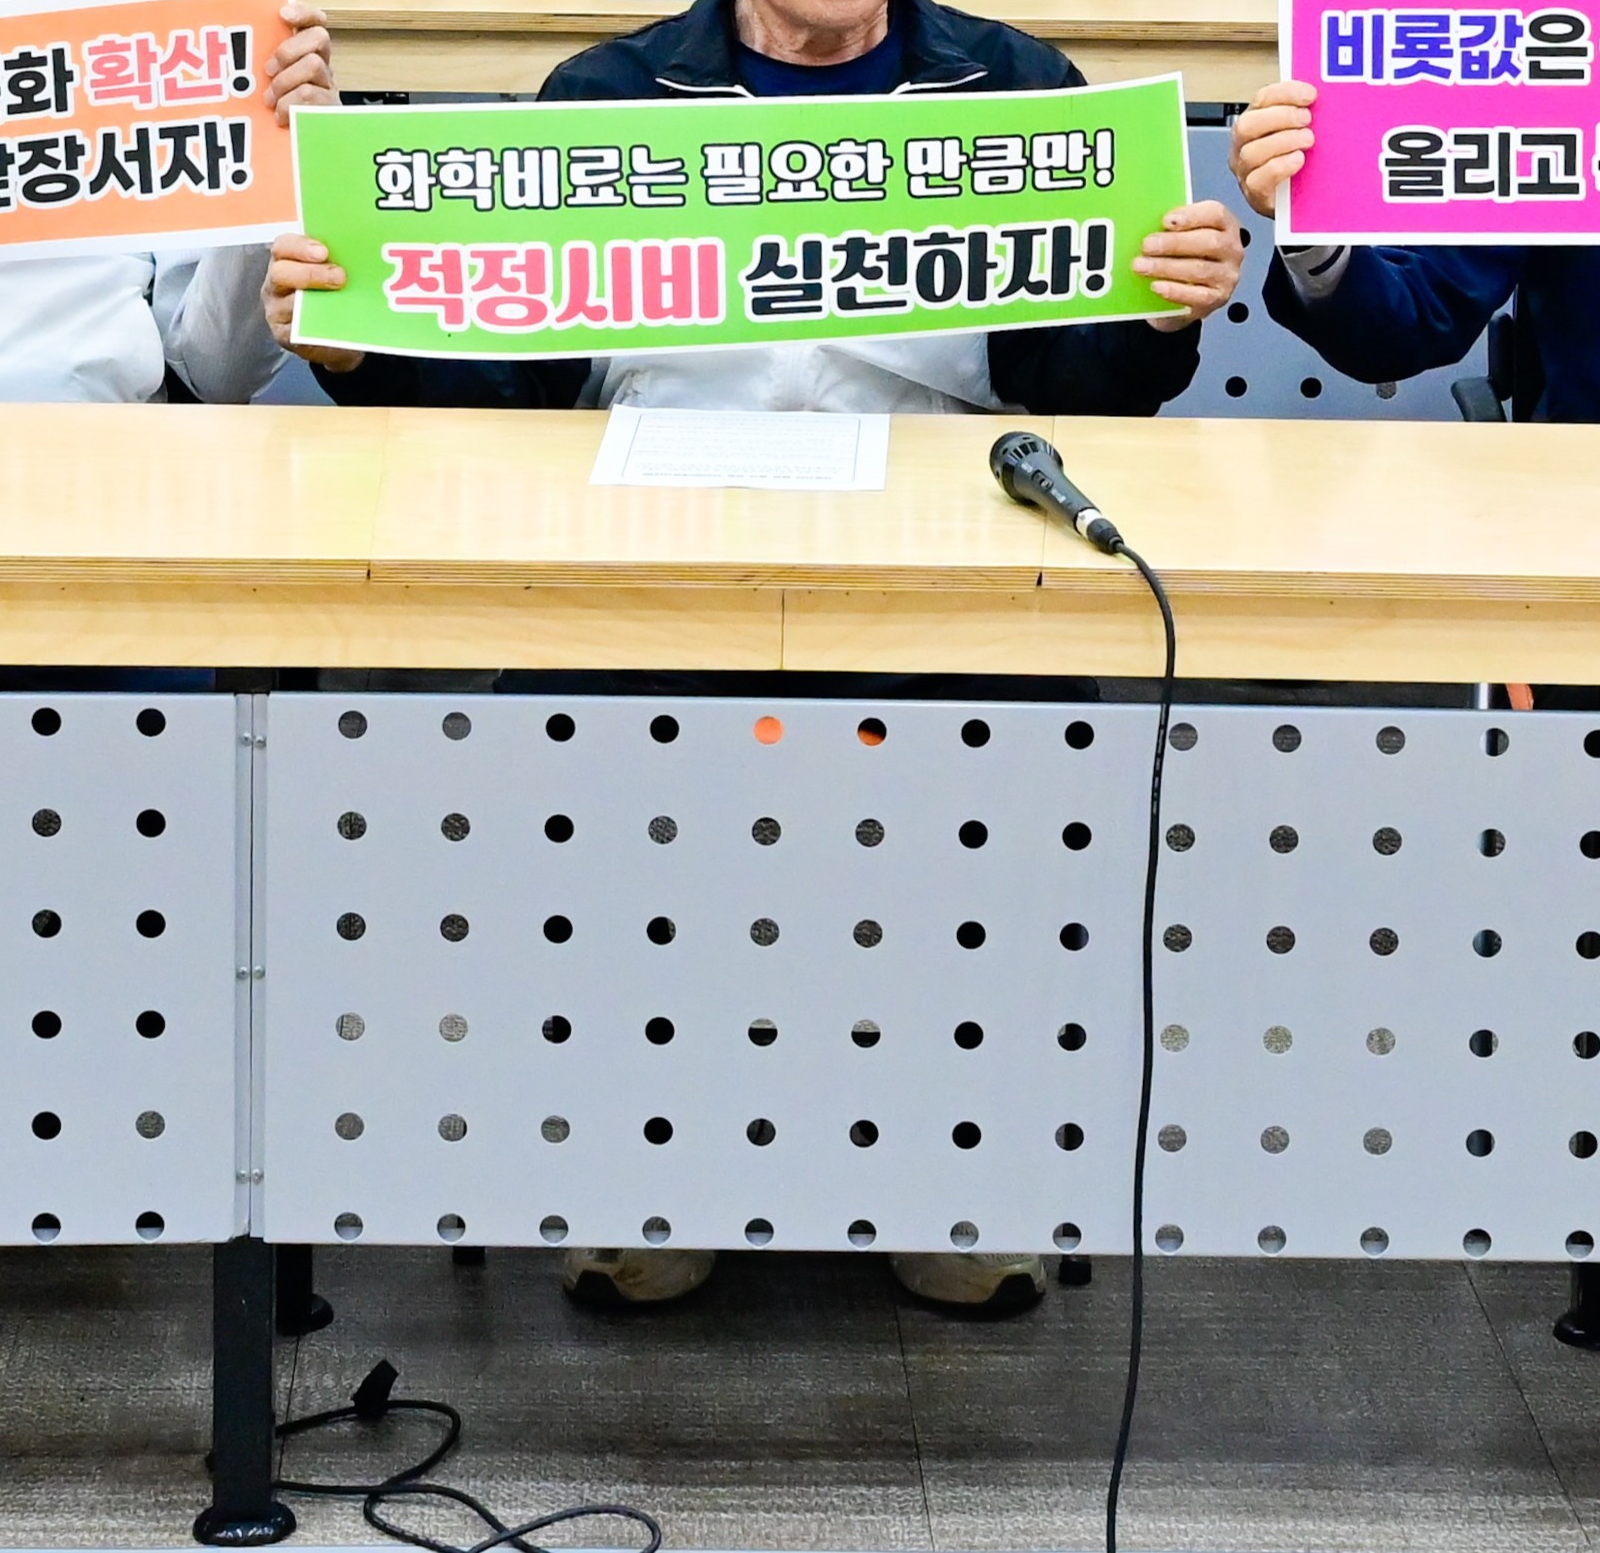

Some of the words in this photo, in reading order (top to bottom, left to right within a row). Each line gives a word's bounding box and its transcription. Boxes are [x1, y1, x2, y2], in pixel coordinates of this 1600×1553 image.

[86, 30, 249, 107] 확산!
[1325, 13, 1588, 81] 비룟값은
[374, 143, 689, 212] 화학비료는
[701, 139, 894, 206] 필요한
[905, 130, 1115, 197] 만큼만!
[1384, 130, 1579, 198] 올리고
[388, 245, 719, 325] 적정시비
[744, 222, 1107, 315] 실천하자!
